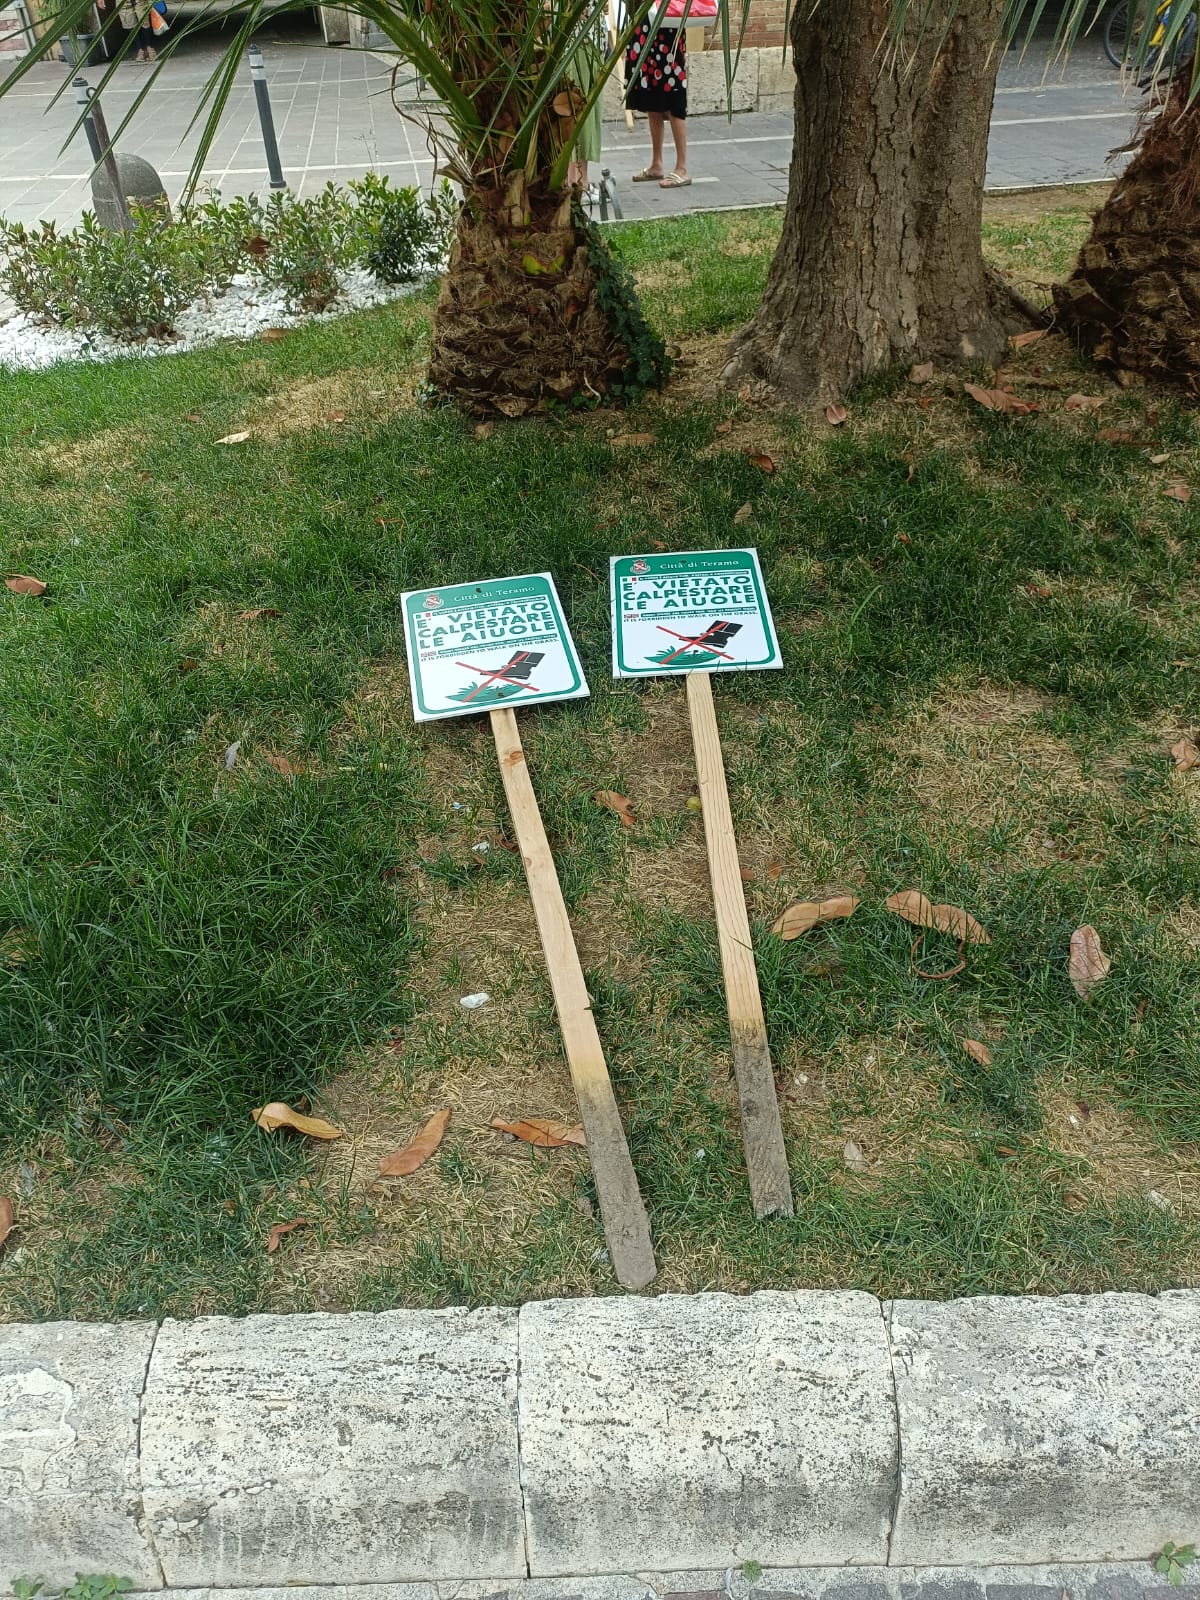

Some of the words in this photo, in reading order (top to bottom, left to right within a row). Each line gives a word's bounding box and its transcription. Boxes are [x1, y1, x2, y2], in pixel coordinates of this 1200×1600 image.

[659, 562, 683, 570] Città
[701, 559, 739, 567] Teramo
[653, 576, 751, 589] VIETATO
[454, 593, 478, 602] Città
[496, 585, 535, 596] Teramo
[623, 585, 753, 601] CALPESTARE
[624, 601, 647, 611] LE
[663, 594, 756, 608] AIUOLE
[448, 602, 549, 623] VIETATO
[418, 611, 552, 638] CALPESTARE
[420, 637, 444, 649] LE
[461, 620, 556, 642] AIUOLE
